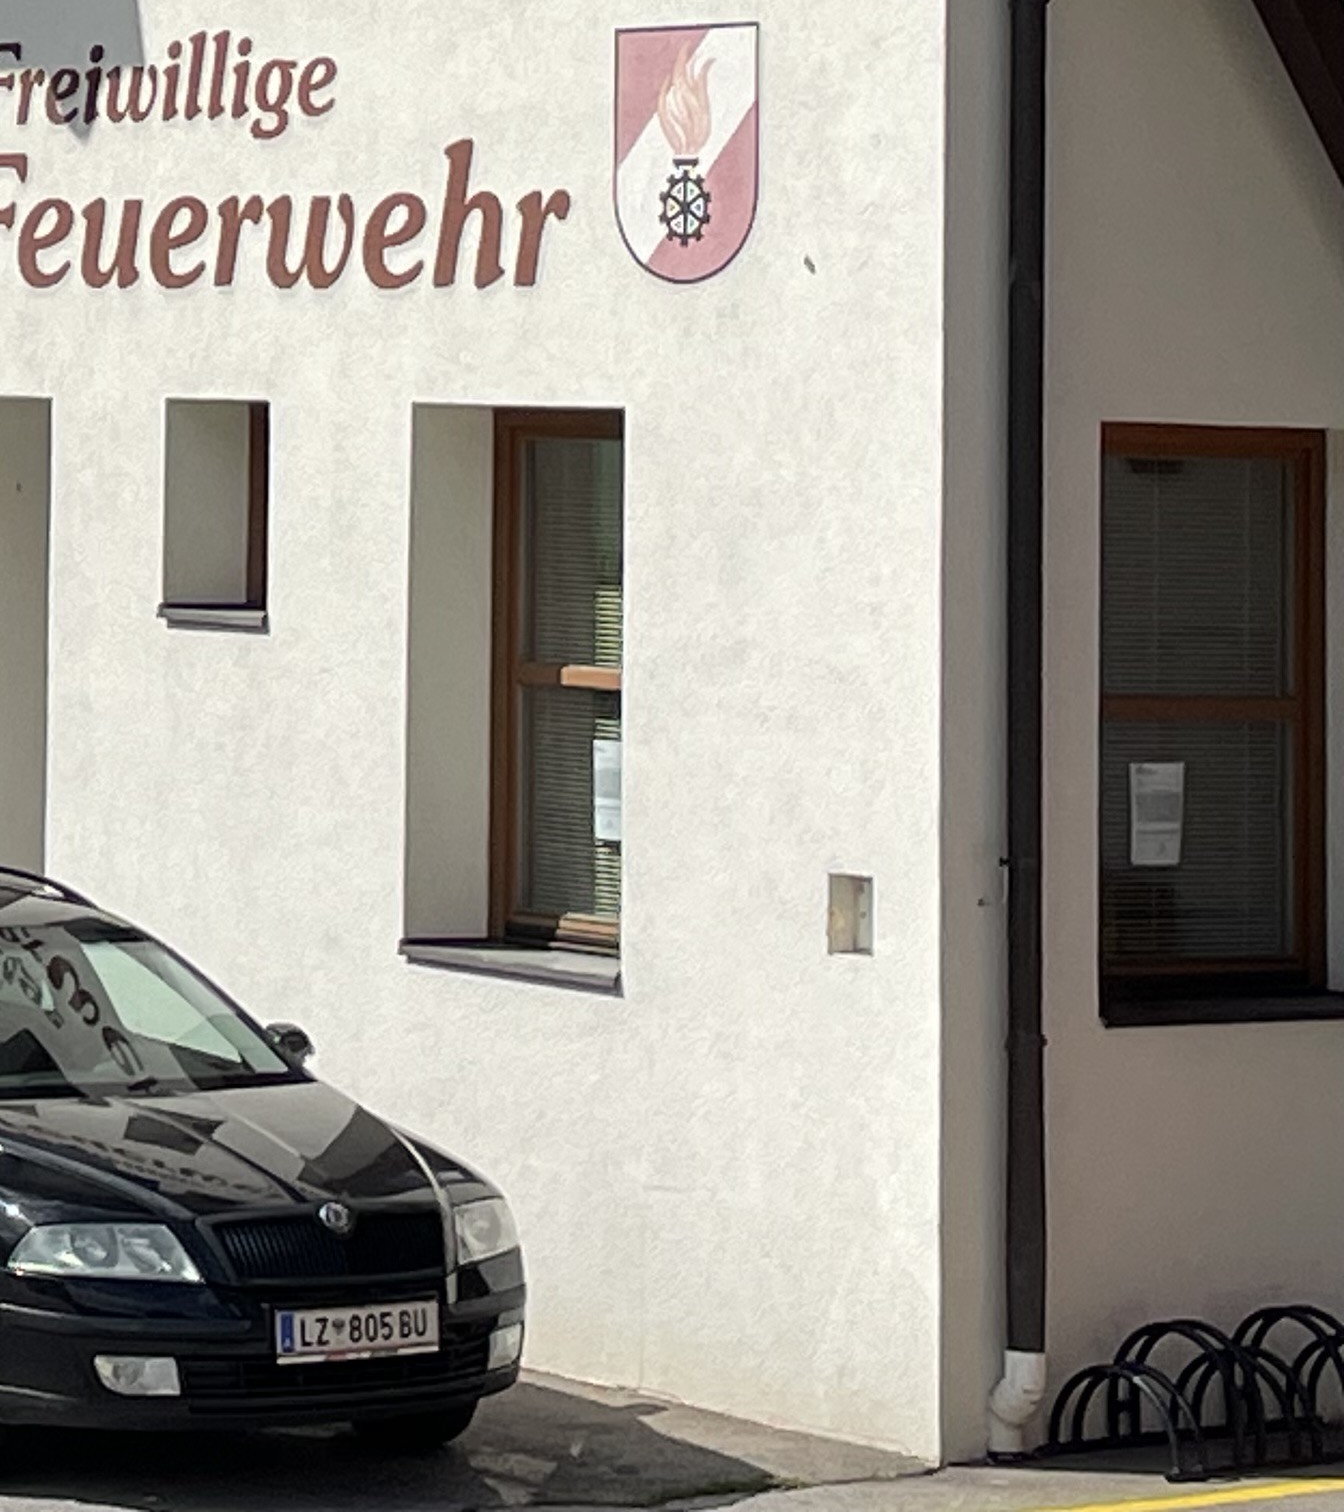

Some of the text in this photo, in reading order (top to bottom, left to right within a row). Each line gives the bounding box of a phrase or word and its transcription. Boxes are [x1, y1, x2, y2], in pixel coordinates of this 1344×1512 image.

[299, 1308, 428, 1347] LZ 805 BU
